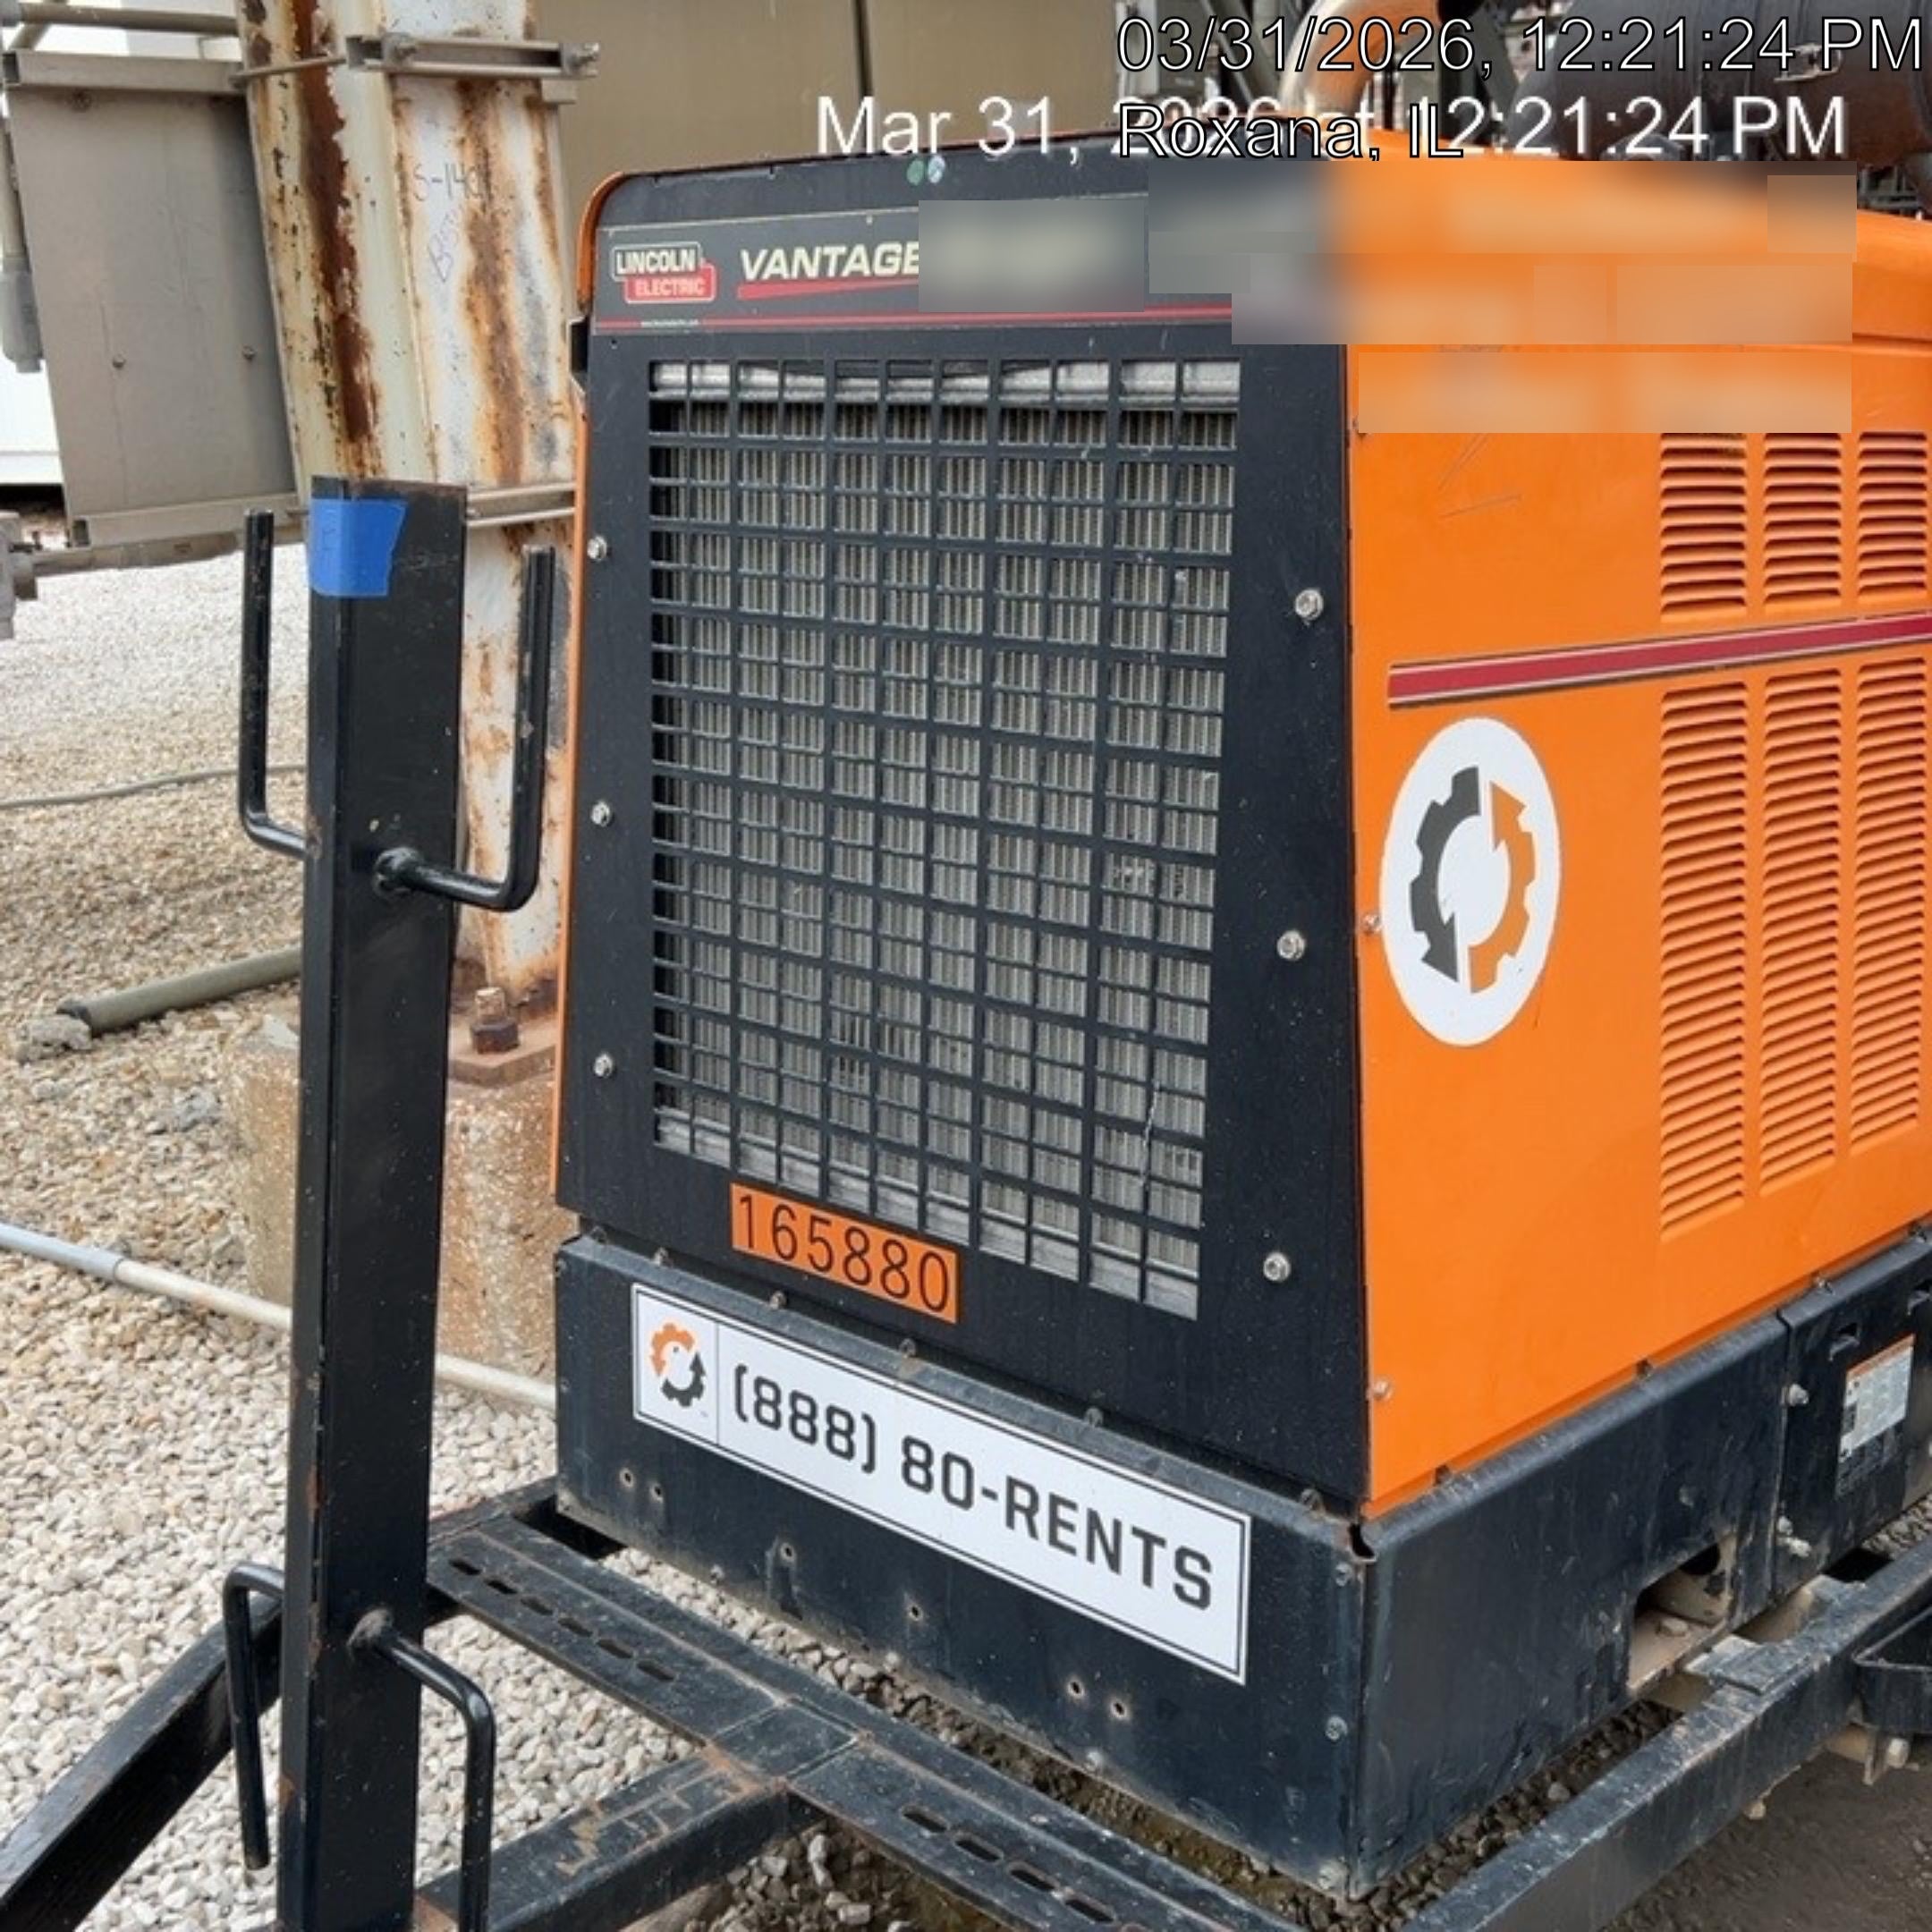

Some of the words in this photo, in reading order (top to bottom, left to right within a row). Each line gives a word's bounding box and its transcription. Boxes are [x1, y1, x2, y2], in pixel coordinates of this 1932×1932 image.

[616, 250, 694, 274] LINCOLN
[740, 241, 919, 280] VANTAGE
[636, 277, 705, 298] ELECTRIC
[739, 1194, 950, 1313] 165880
[733, 1364, 877, 1474] (888)
[901, 1435, 1212, 1611] 80-RENTS
